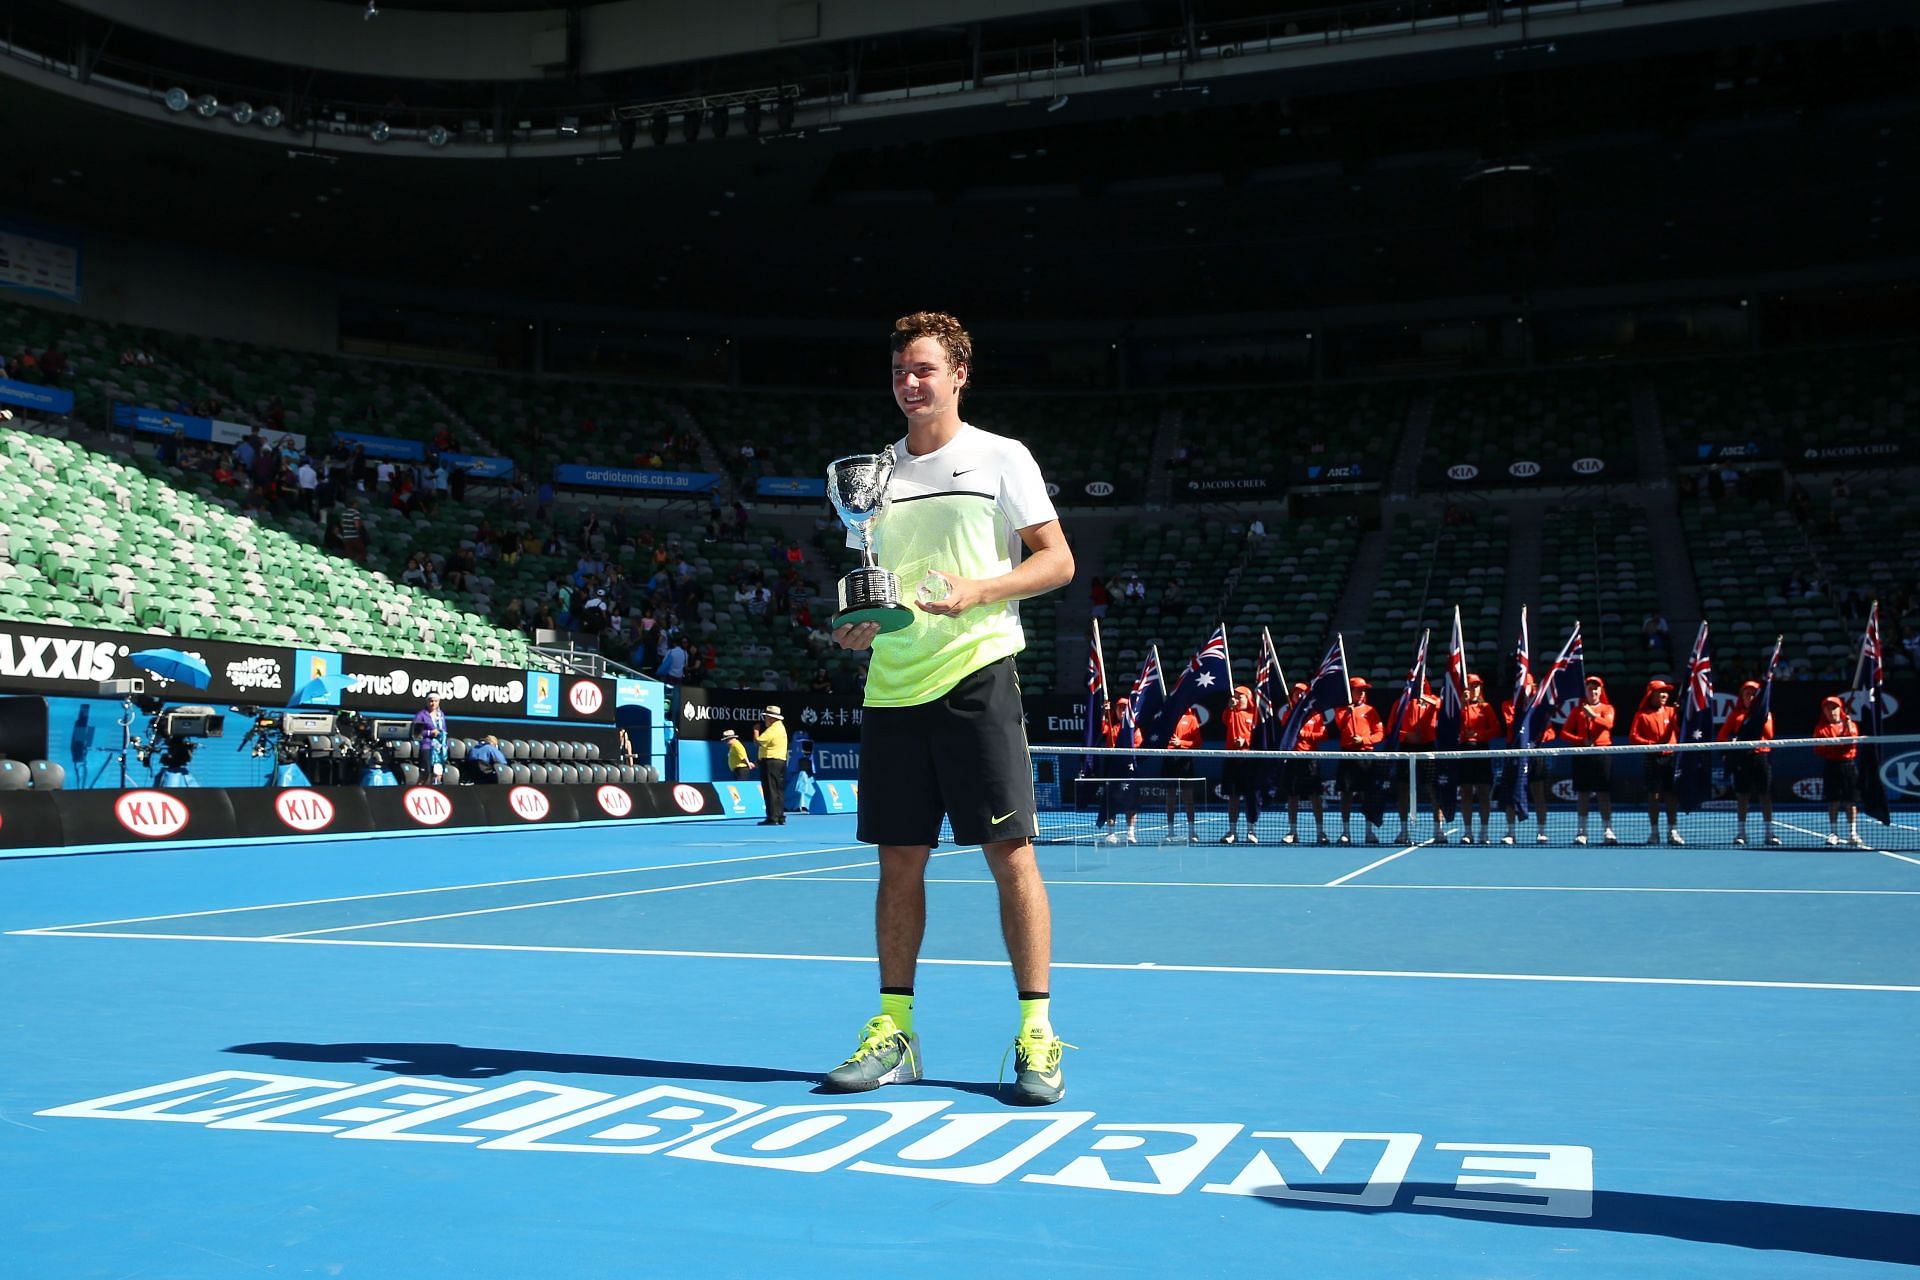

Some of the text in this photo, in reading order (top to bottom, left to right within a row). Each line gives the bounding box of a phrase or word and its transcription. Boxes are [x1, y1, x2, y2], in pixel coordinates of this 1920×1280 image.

[1326, 467, 1350, 477] ANZ
[1451, 466, 1475, 478] KIA
[1513, 463, 1537, 475] KIA
[1576, 460, 1600, 472] KIA
[585, 469, 689, 487] cardiotennis.com.au
[1089, 484, 1110, 494] KIA
[412, 679, 454, 700] OPTUS
[471, 684, 510, 704] OPTUS
[575, 688, 597, 707] KIA
[732, 707, 765, 721] CREEK
[413, 794, 445, 817] KIA
[516, 794, 543, 812] KIA
[603, 792, 628, 810] KIA
[678, 791, 701, 807] KIA
[127, 801, 179, 826] KIA
[285, 798, 327, 822] KIA
[32, 1070, 1594, 1218] MELBOURNE
